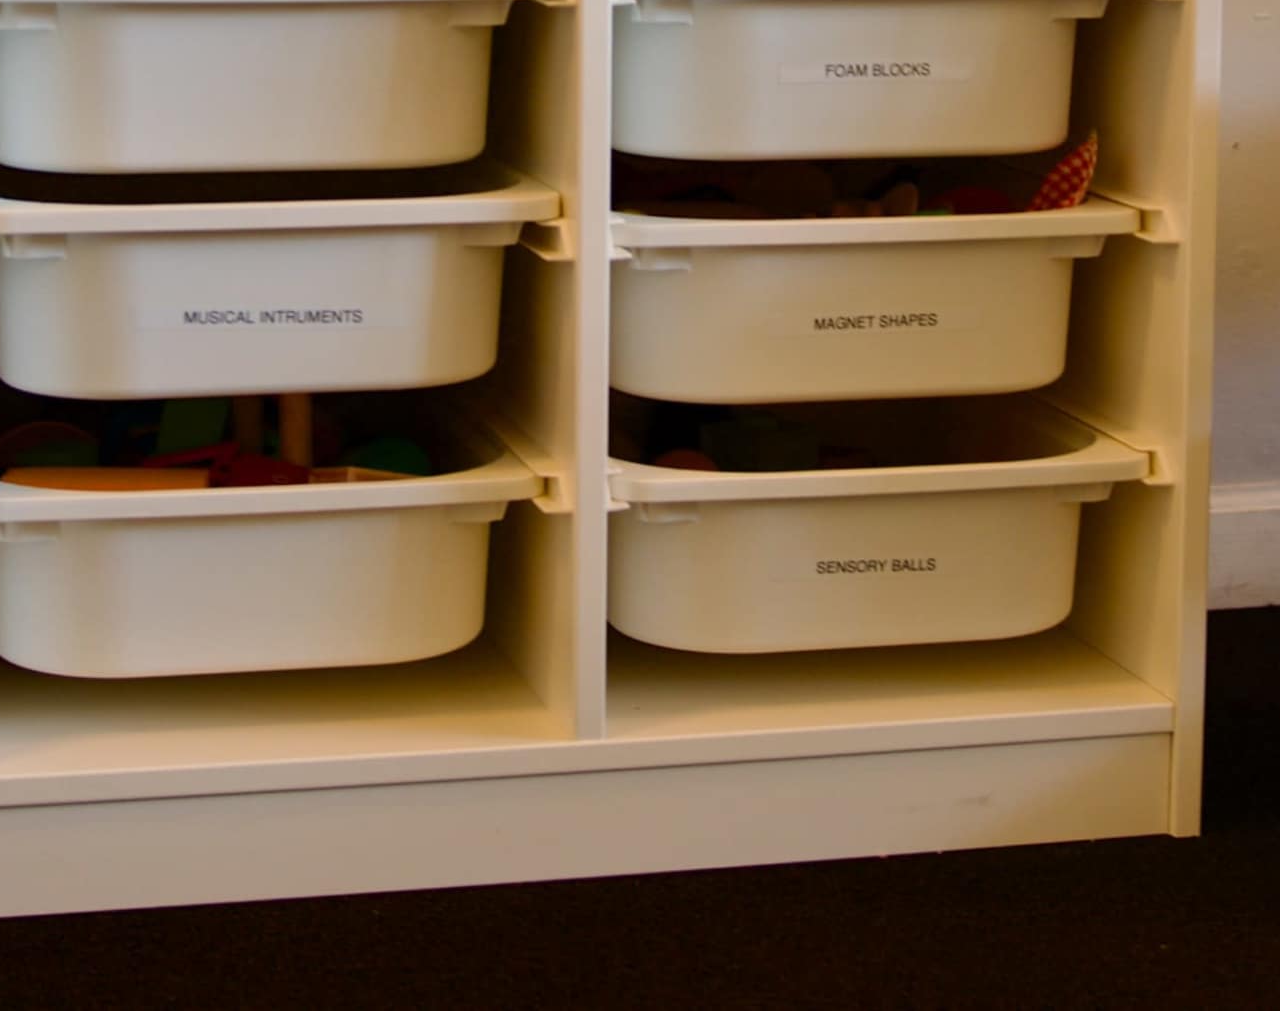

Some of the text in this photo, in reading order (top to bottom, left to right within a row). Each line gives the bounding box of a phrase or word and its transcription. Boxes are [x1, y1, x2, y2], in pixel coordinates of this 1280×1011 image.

[825, 62, 931, 78] FOAM BLOCKS
[183, 309, 363, 324] MUSICAL INTRUMENTS
[813, 312, 938, 330] MAGNET SHAPES
[816, 557, 936, 574] SENSORY BALLS
